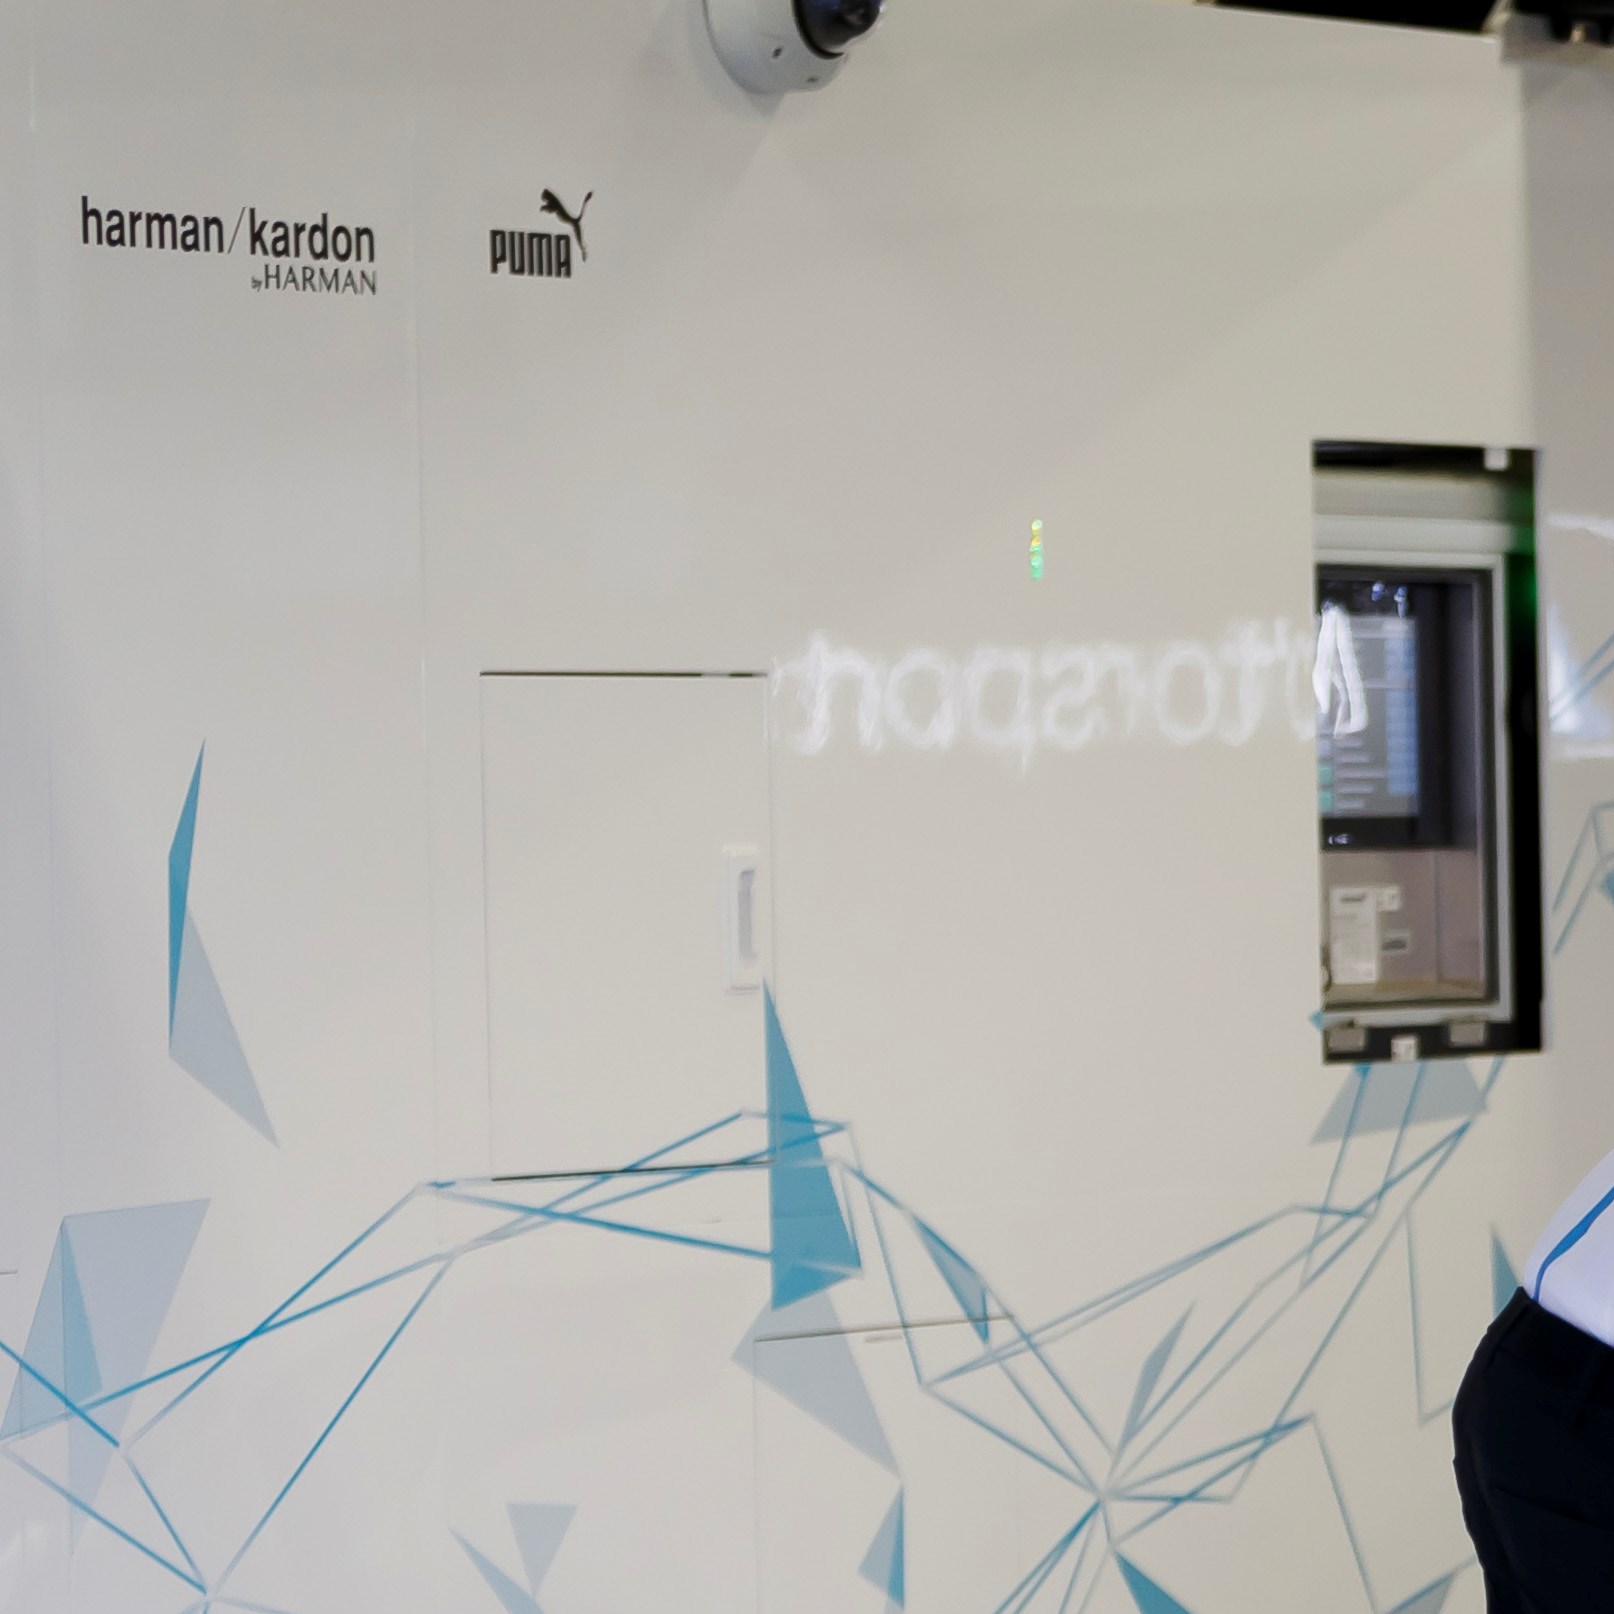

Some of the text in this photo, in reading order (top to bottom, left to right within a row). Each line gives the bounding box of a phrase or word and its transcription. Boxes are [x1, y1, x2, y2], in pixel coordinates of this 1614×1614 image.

[82, 195, 375, 263] harman/kardon
[489, 229, 572, 278] PUMA
[263, 264, 377, 295] HARMAN
